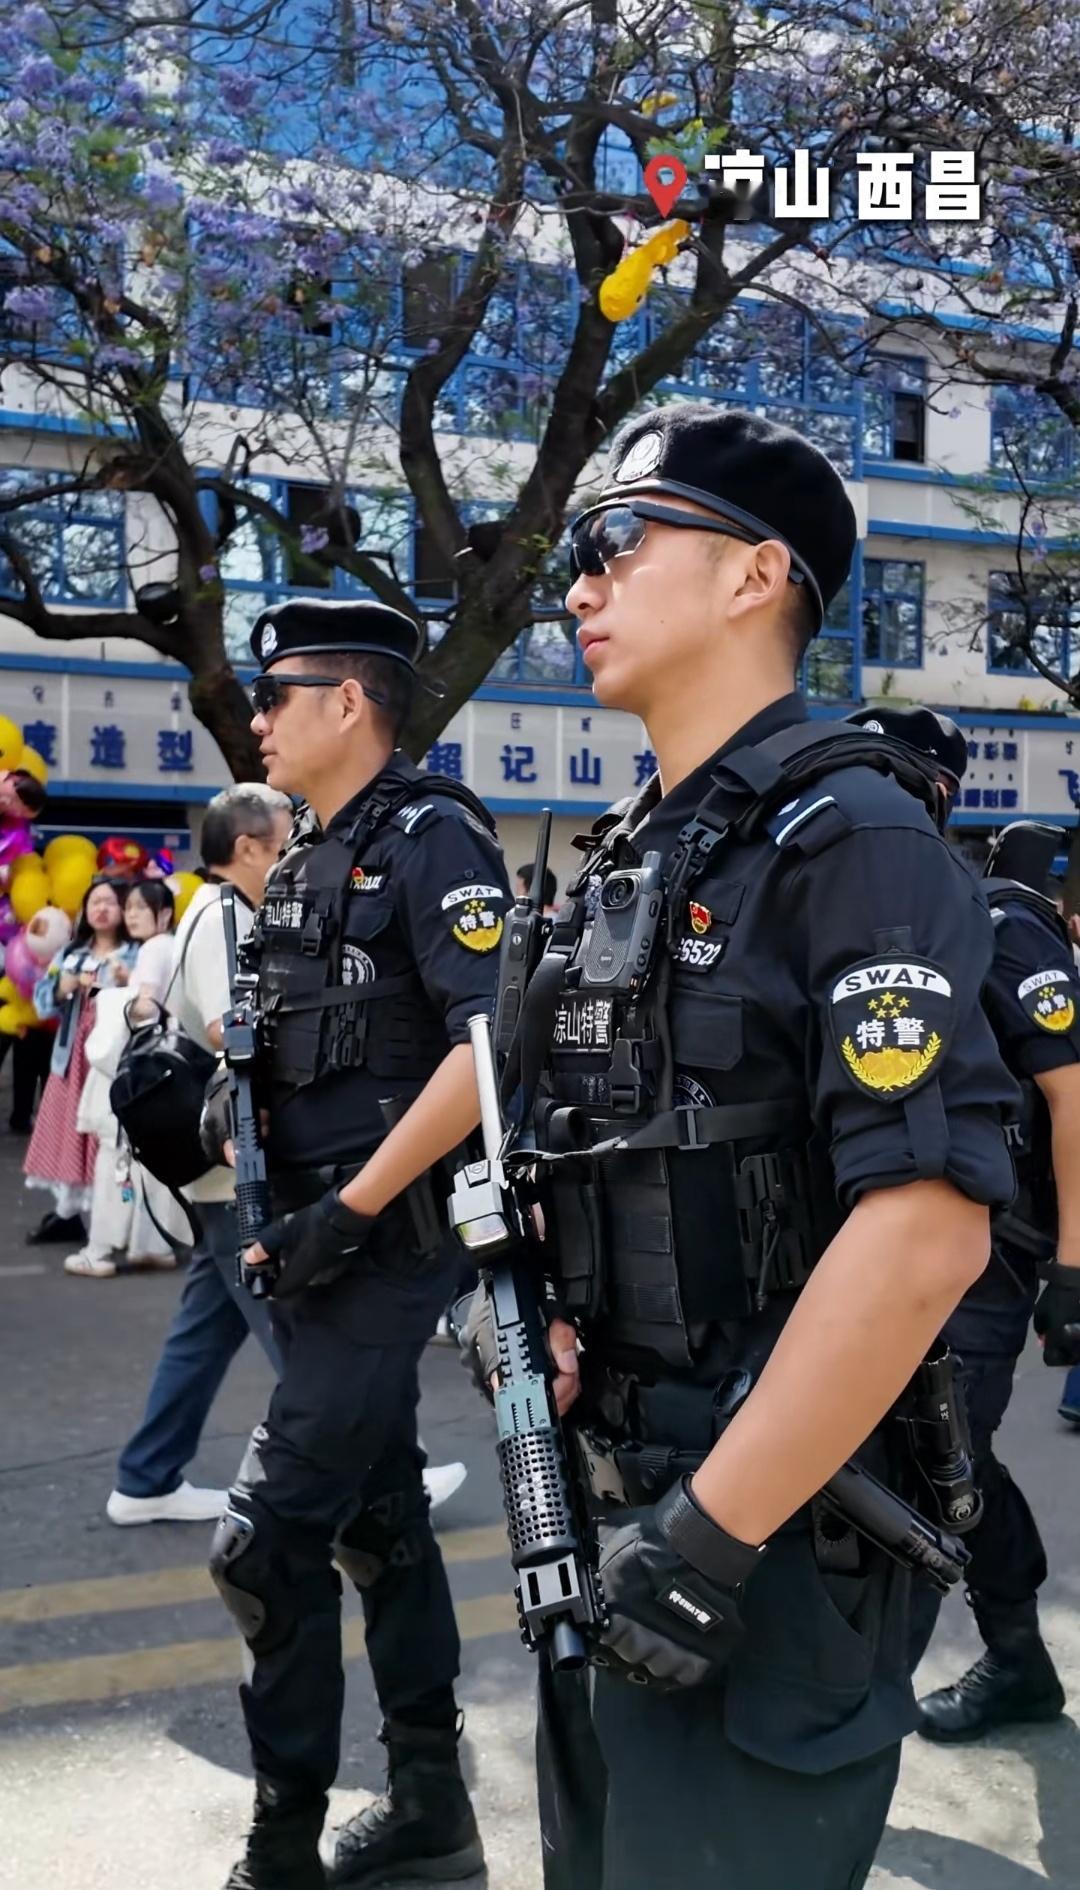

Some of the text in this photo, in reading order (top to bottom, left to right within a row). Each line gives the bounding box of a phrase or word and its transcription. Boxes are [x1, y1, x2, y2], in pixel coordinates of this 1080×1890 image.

[447, 888, 494, 903] SWAT
[459, 910, 496, 932] 特警
[845, 967, 937, 992] SWAT
[1022, 972, 1059, 992] SWAT
[553, 999, 612, 1045] 凉山特警
[856, 1016, 925, 1050] 特警
